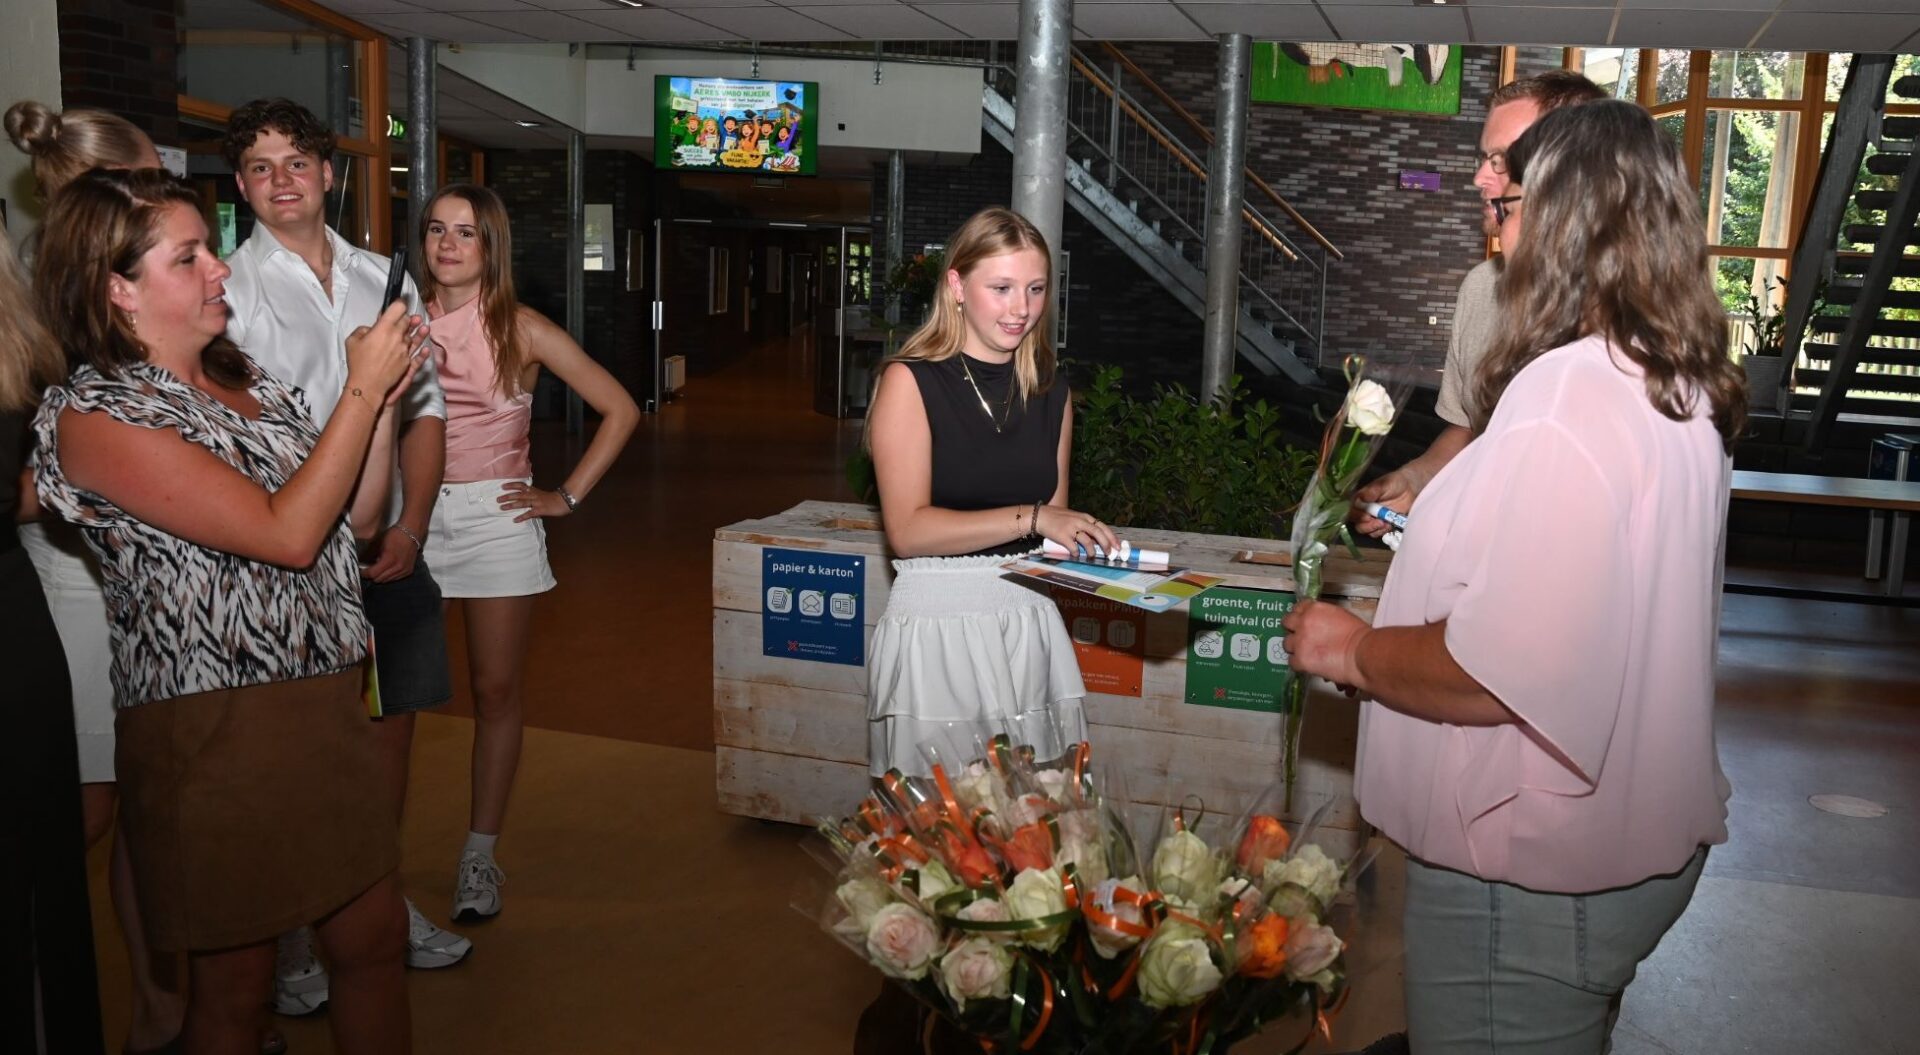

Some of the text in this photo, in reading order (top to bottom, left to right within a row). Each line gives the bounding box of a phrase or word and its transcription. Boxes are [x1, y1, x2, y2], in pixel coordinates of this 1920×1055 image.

[694, 88, 719, 96] AERES
[721, 89, 742, 97] VMBO
[772, 563, 854, 578] papier & karton
[1058, 597, 1106, 610] kpakken
[1202, 597, 1252, 610] groente,
[1256, 600, 1284, 612] fruit
[1204, 612, 1282, 628] tuinafval (GF
